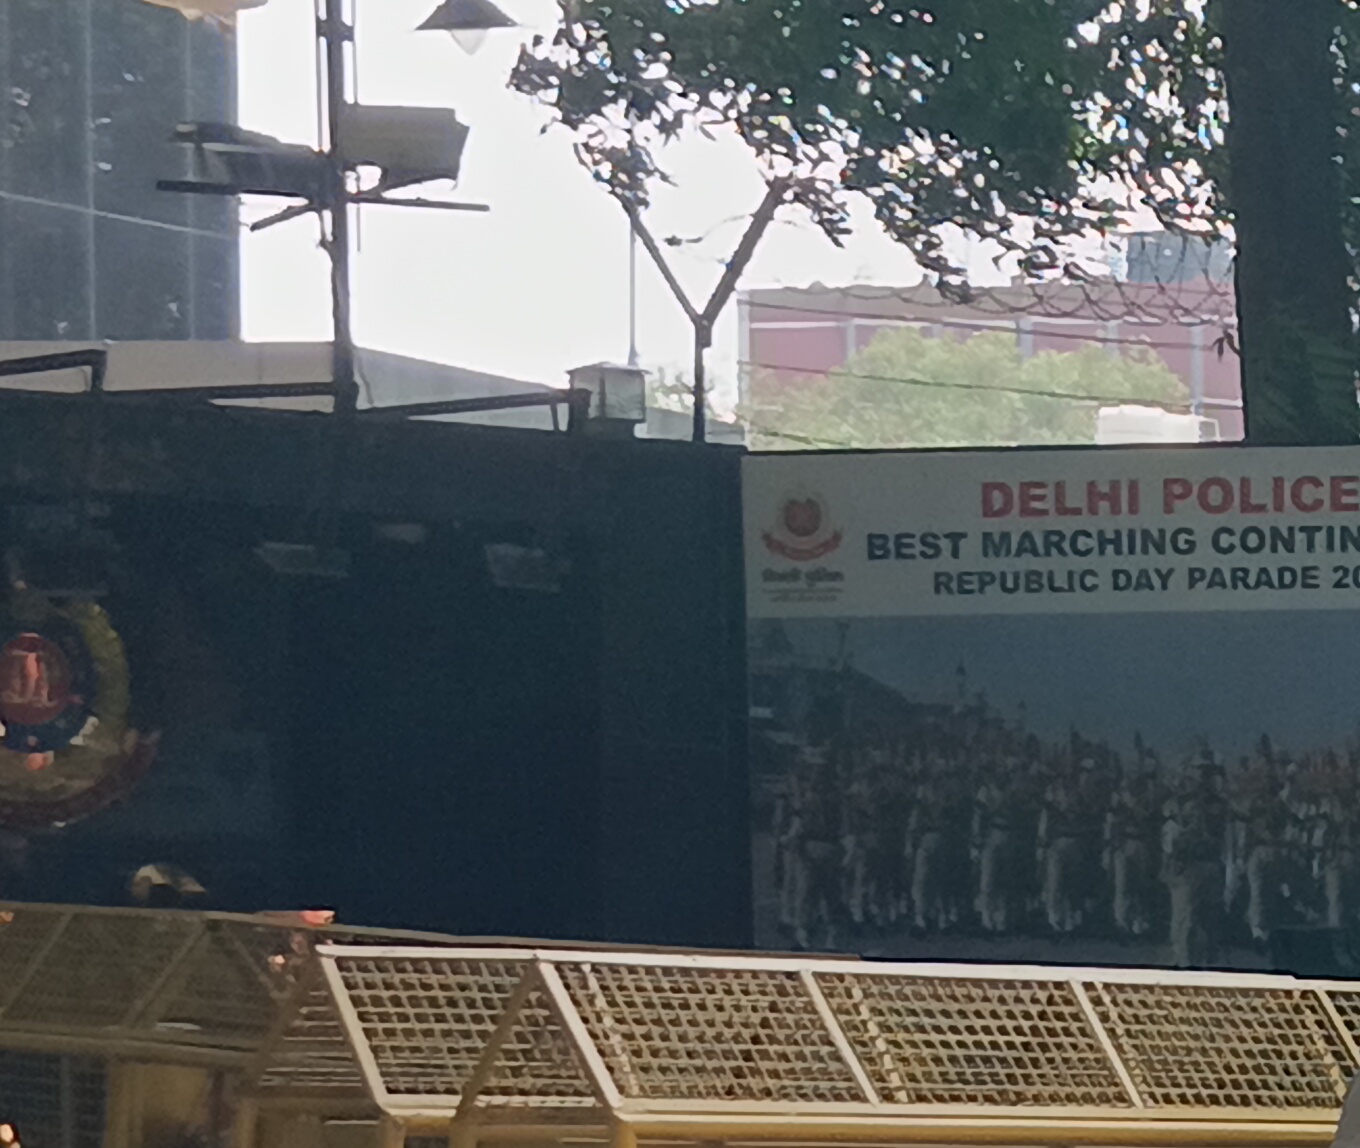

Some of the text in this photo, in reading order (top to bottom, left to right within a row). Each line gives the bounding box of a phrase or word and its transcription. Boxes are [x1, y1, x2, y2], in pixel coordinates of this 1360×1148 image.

[981, 475, 1360, 518] DELHI POLICE
[866, 531, 968, 561] BEST
[982, 527, 1197, 558] MARCHING
[933, 568, 1099, 595] REPUBLIC
[1112, 566, 1175, 592] DAY
[1188, 565, 1321, 590] PARADE
